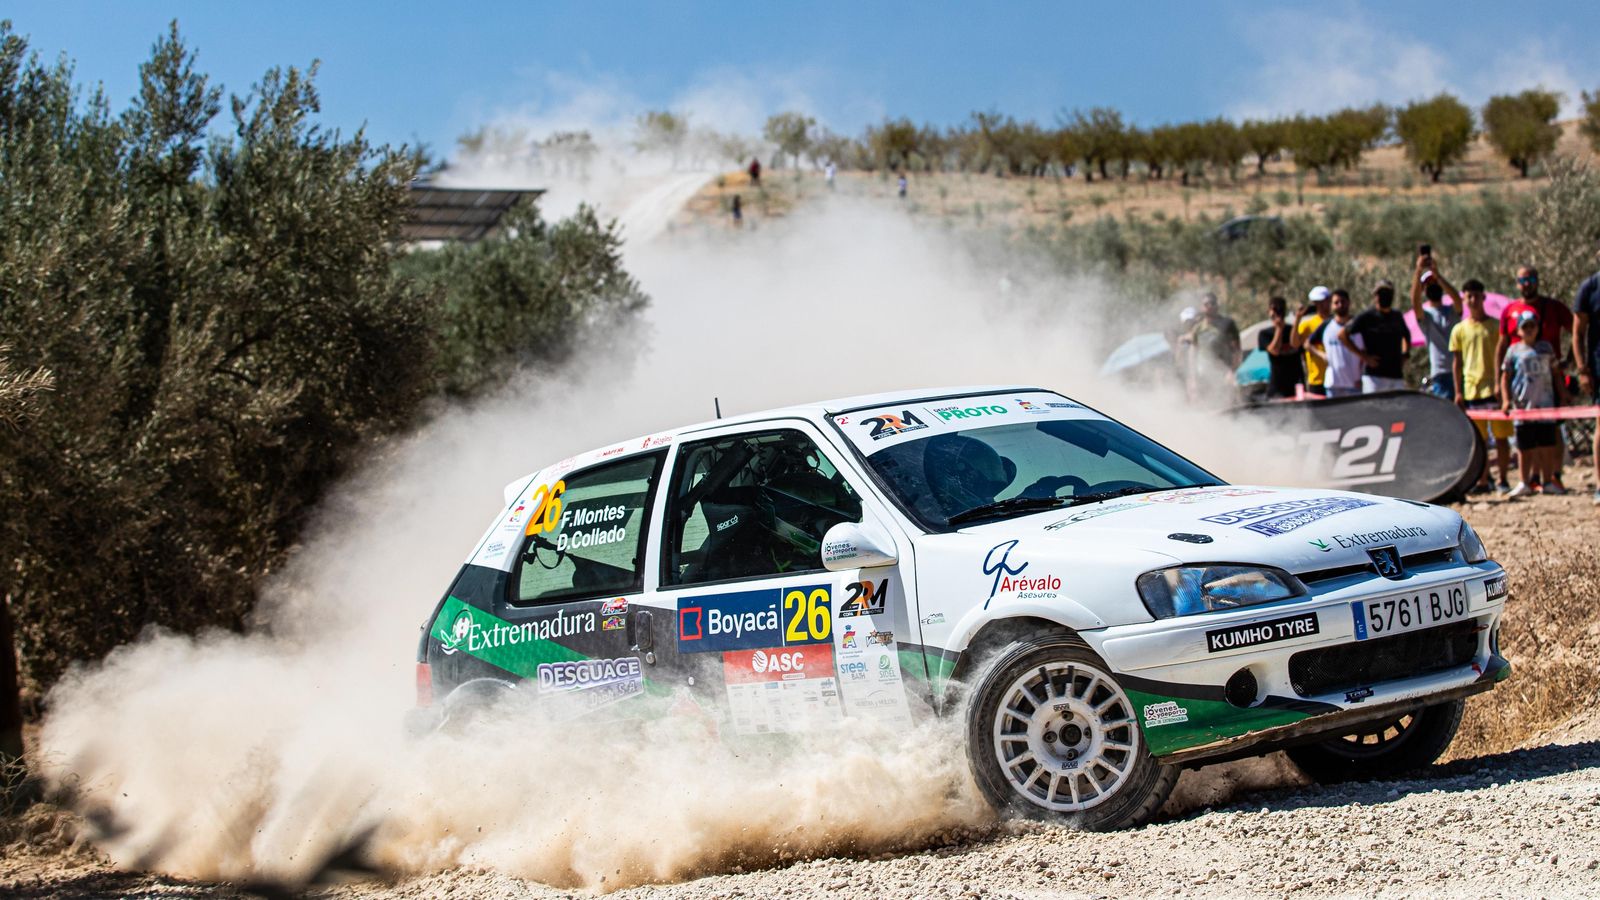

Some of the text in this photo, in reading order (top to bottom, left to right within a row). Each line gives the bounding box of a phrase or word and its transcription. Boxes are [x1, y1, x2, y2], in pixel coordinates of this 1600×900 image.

[938, 405, 1008, 421] PROTO
[524, 479, 566, 537] 26
[560, 504, 625, 529] F.Montes
[557, 527, 625, 552] D.Collado
[1332, 524, 1428, 549] Extremadura
[1000, 574, 1061, 593] Arévalo
[1017, 591, 1057, 599] Asesores
[708, 603, 778, 638] Boyacá
[784, 588, 831, 642] 26
[1369, 587, 1465, 633] 5761 BJG
[468, 609, 596, 652] Extremadura
[1211, 617, 1315, 650] KUMHO TYRE
[1359, 624, 1364, 633] E
[768, 652, 805, 673] ASC
[540, 662, 640, 689] DESGUACE
